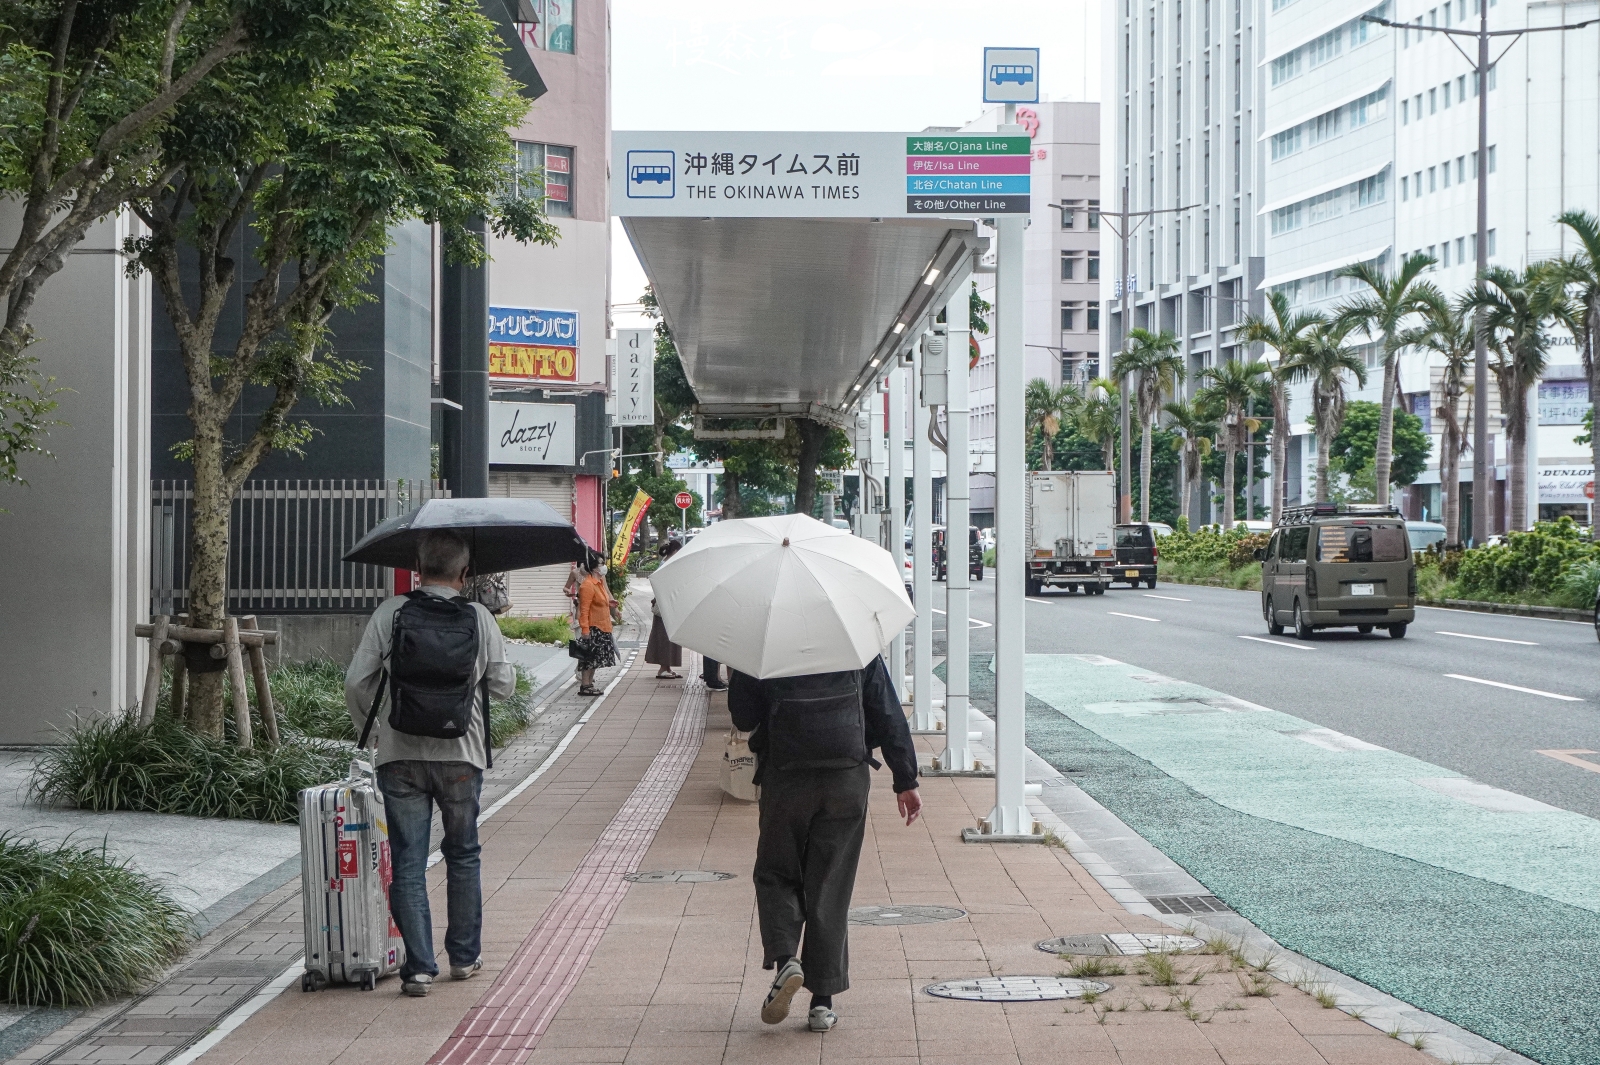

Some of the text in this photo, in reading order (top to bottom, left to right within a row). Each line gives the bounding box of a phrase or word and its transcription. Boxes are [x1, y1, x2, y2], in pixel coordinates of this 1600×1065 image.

[913, 141, 1008, 153] 大謝名/Ojana Line
[684, 152, 860, 176] 沖縄タイムス前
[913, 160, 979, 171] 伊佐/Isa Line
[913, 179, 1003, 190] 北谷/Chatan Line
[686, 185, 860, 199] THE OKINAWA TIMES
[913, 199, 1006, 210] その他/Other Line
[489, 346, 577, 377] GINTO
[628, 332, 641, 413] dazzy
[622, 413, 648, 421] store
[501, 409, 557, 460] dazzy
[519, 444, 542, 452] store
[1543, 469, 1595, 477] DUNLOP
[613, 514, 635, 562] ソーキそば
